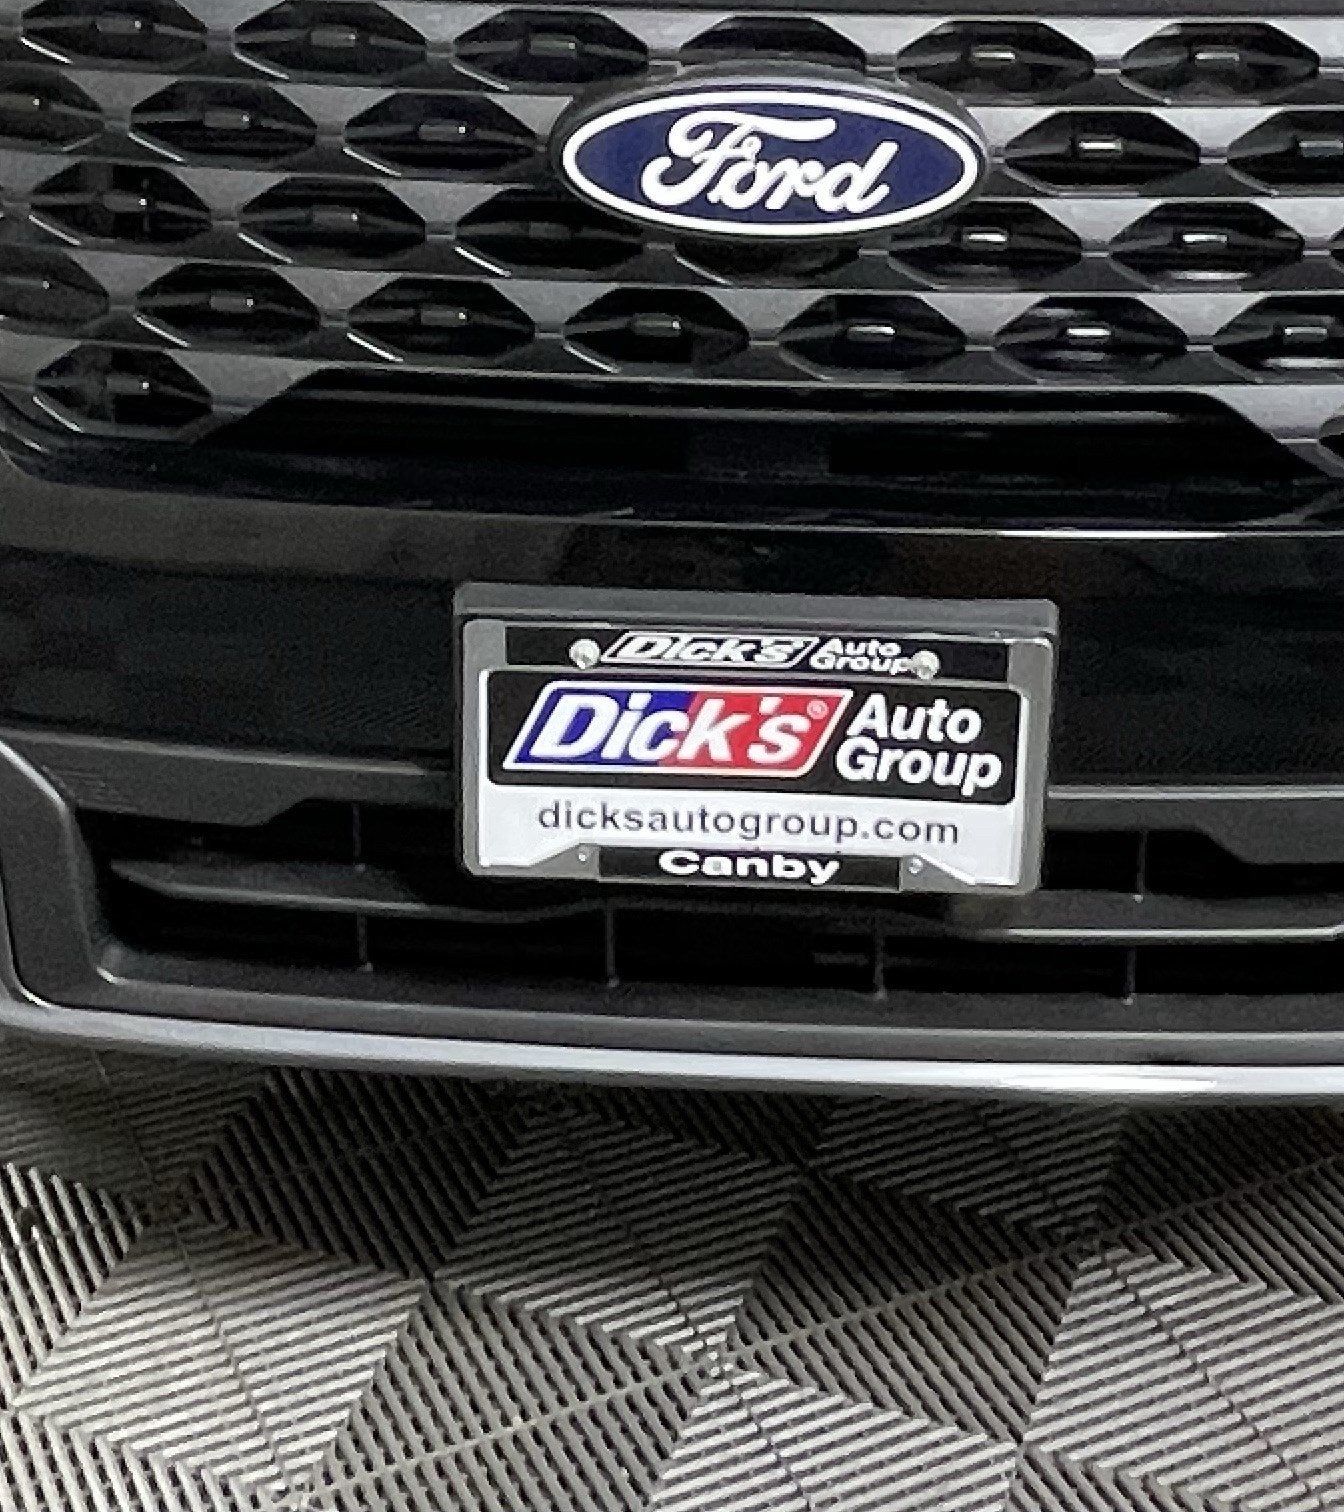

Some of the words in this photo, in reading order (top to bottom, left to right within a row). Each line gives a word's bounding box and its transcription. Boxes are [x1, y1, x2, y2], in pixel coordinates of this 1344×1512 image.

[640, 109, 900, 214] Ford
[824, 637, 902, 657] Auto
[528, 691, 812, 764] Dick's
[846, 692, 983, 744] Auto
[835, 736, 1003, 797] Group
[537, 800, 960, 845] dicksautogroup.com
[657, 849, 841, 887] Canby
